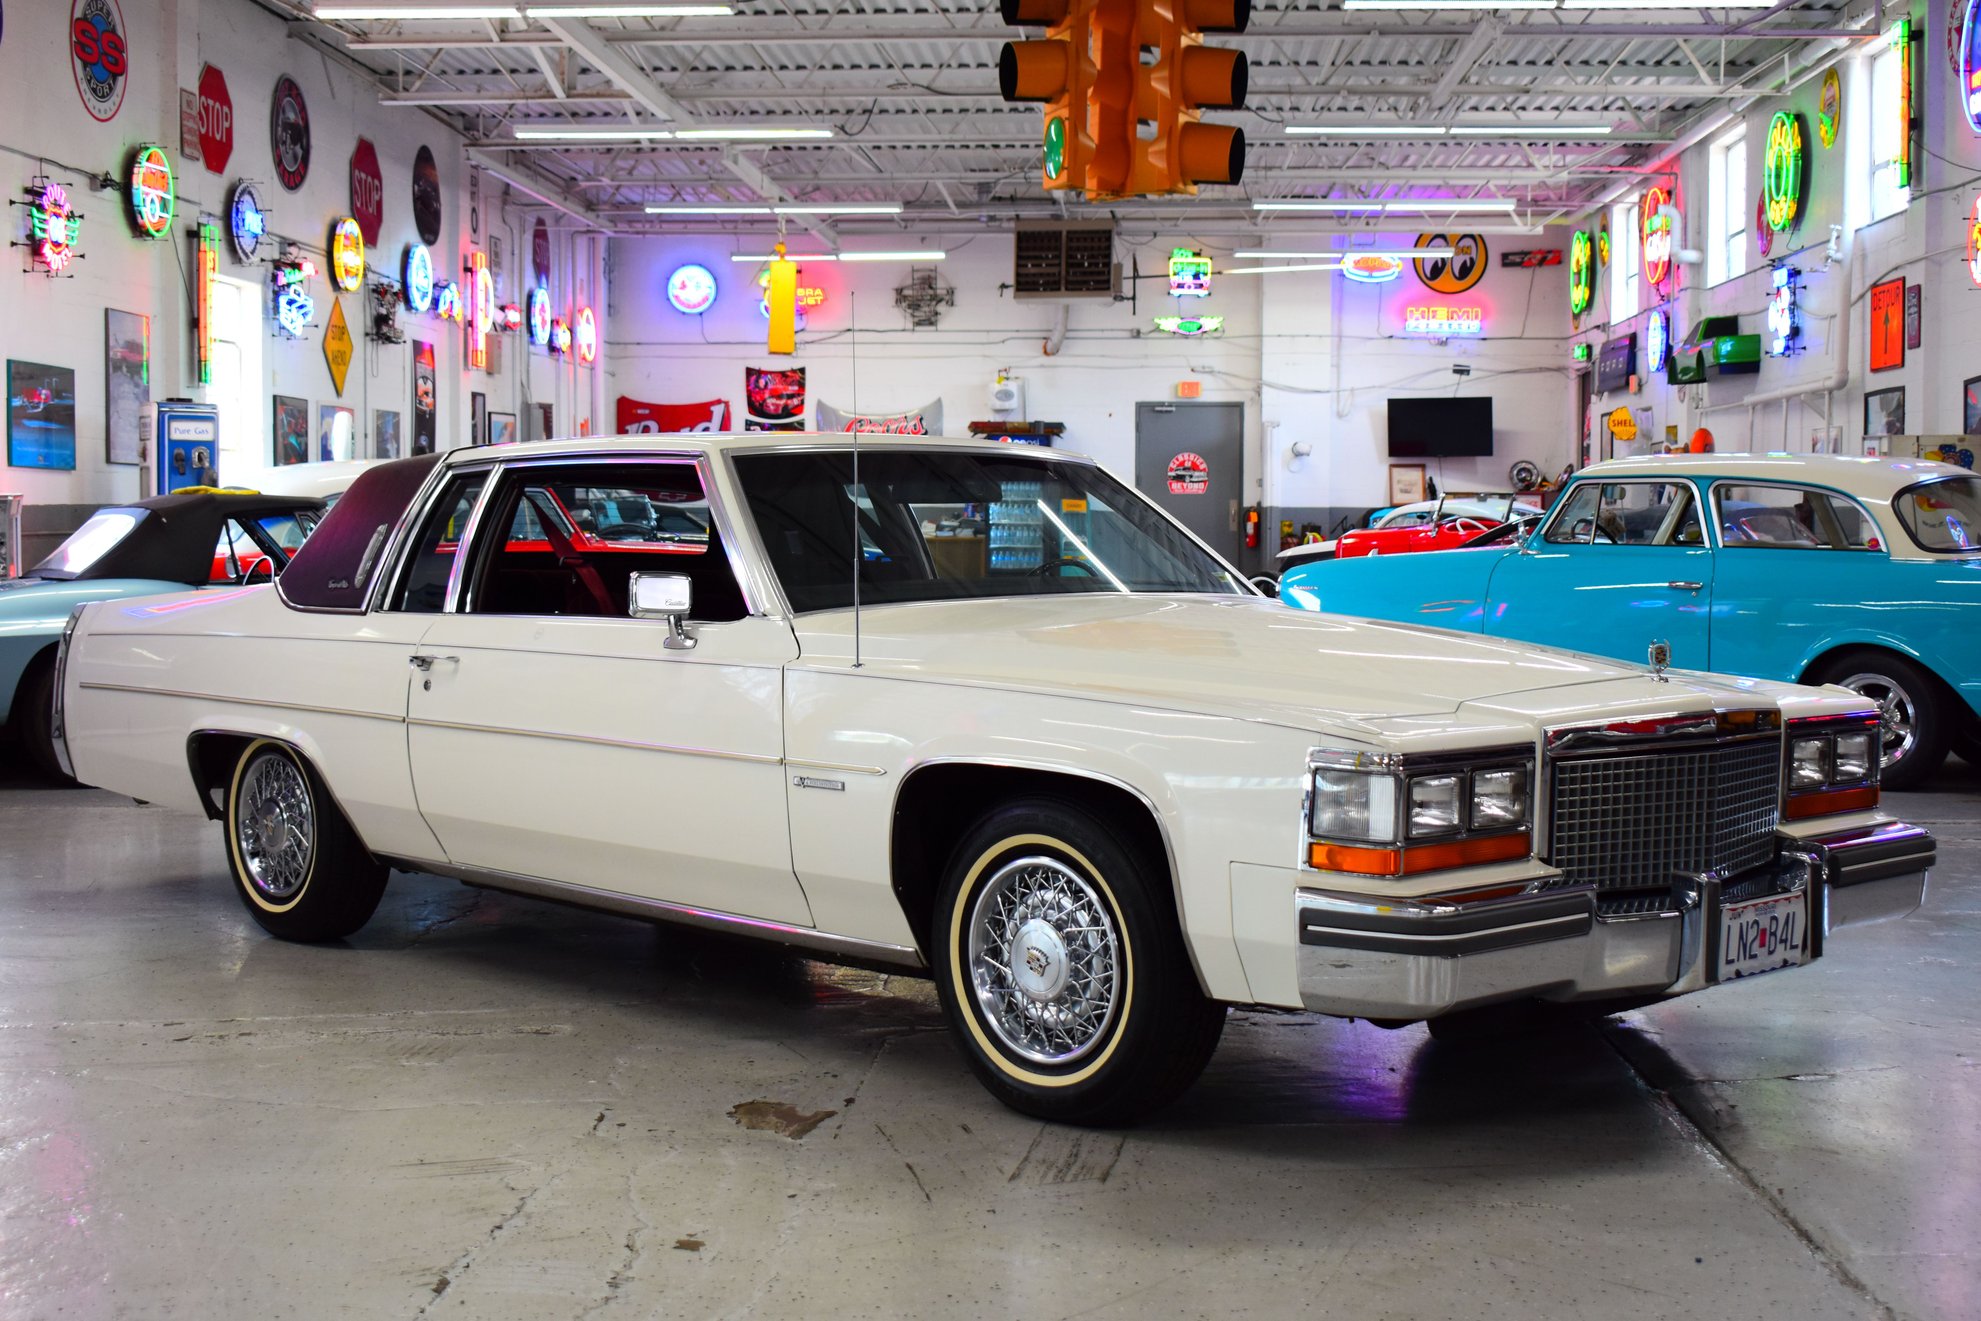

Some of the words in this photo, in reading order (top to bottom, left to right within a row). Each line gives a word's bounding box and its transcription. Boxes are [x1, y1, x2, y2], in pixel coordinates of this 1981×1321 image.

[73, 17, 126, 76] SS
[200, 95, 231, 143] STOP
[353, 168, 382, 216] STOP
[798, 297, 823, 305] JET
[1872, 285, 1901, 312] DETOUR
[1407, 307, 1481, 321] HEMI
[331, 324, 346, 342] STOP
[1171, 482, 1205, 490] BEYOND
